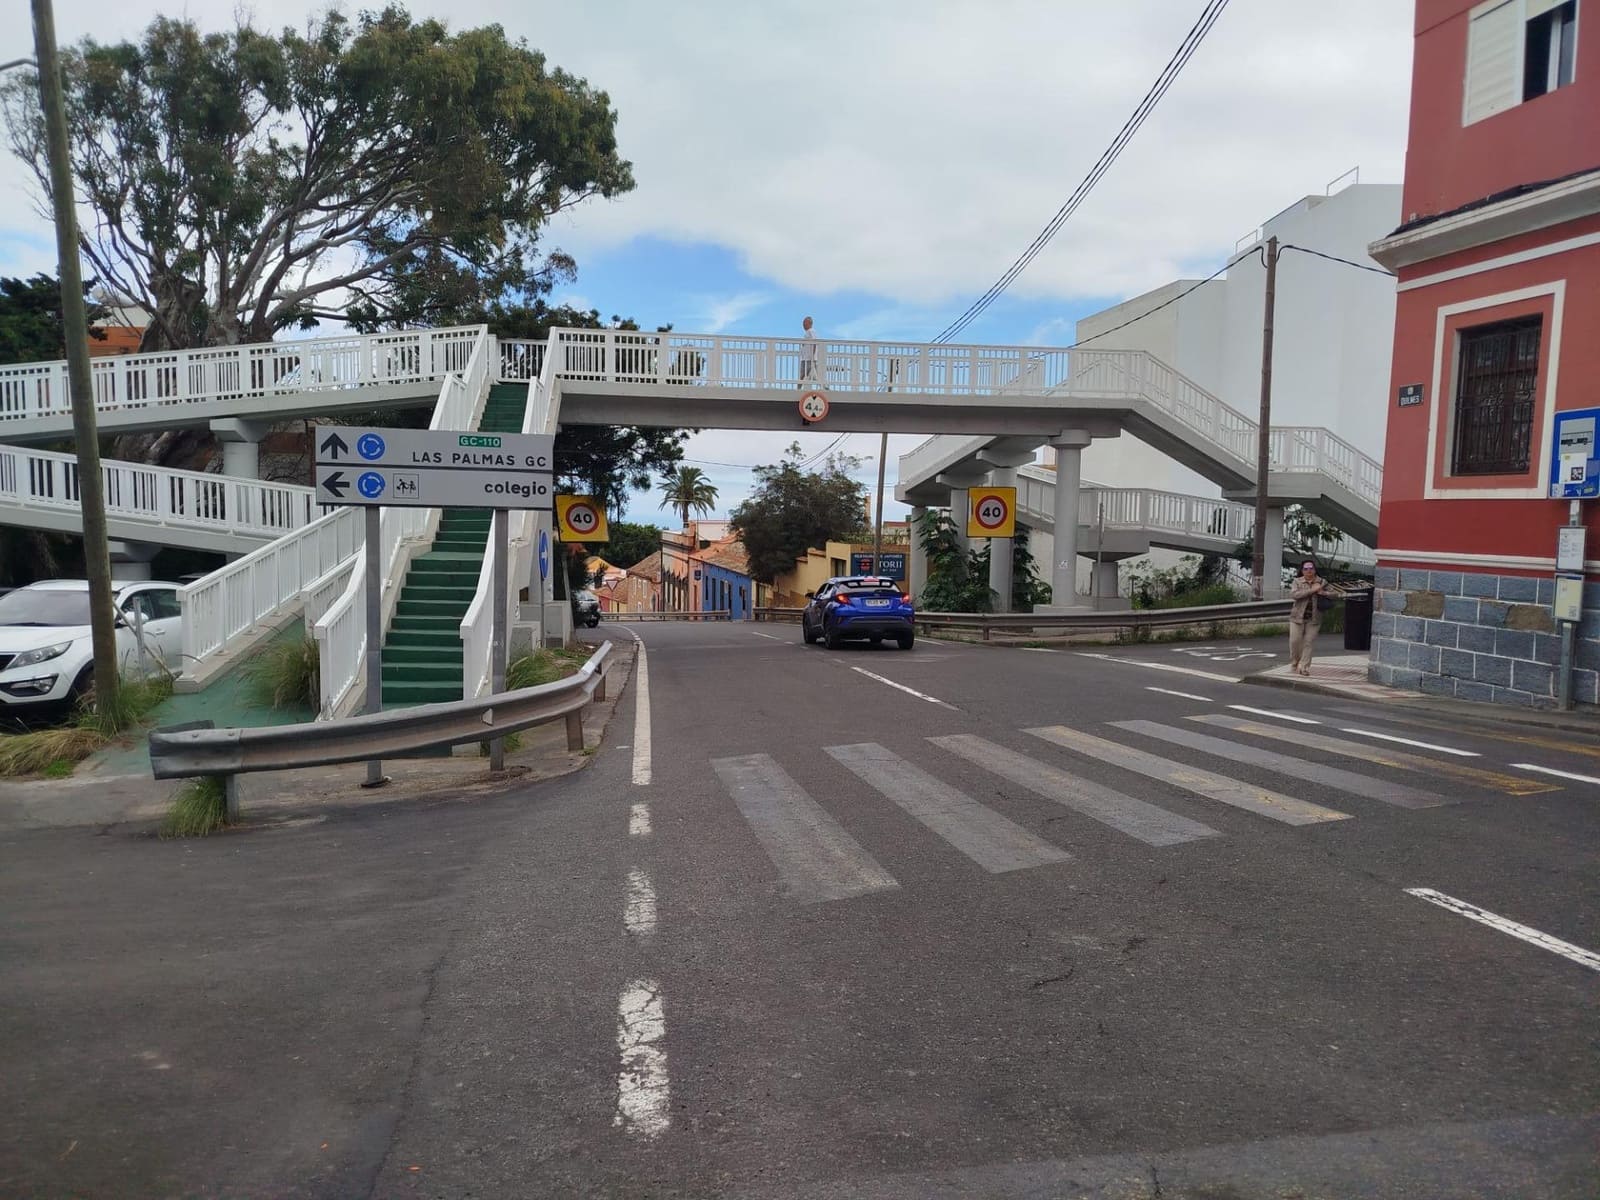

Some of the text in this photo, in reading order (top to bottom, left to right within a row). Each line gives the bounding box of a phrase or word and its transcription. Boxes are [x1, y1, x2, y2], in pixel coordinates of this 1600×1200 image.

[460, 436, 501, 447] GC-110
[412, 451, 547, 467] LAS PALMAS GC
[484, 481, 547, 497] colegio
[982, 507, 1001, 518] 40
[573, 513, 593, 525] 40
